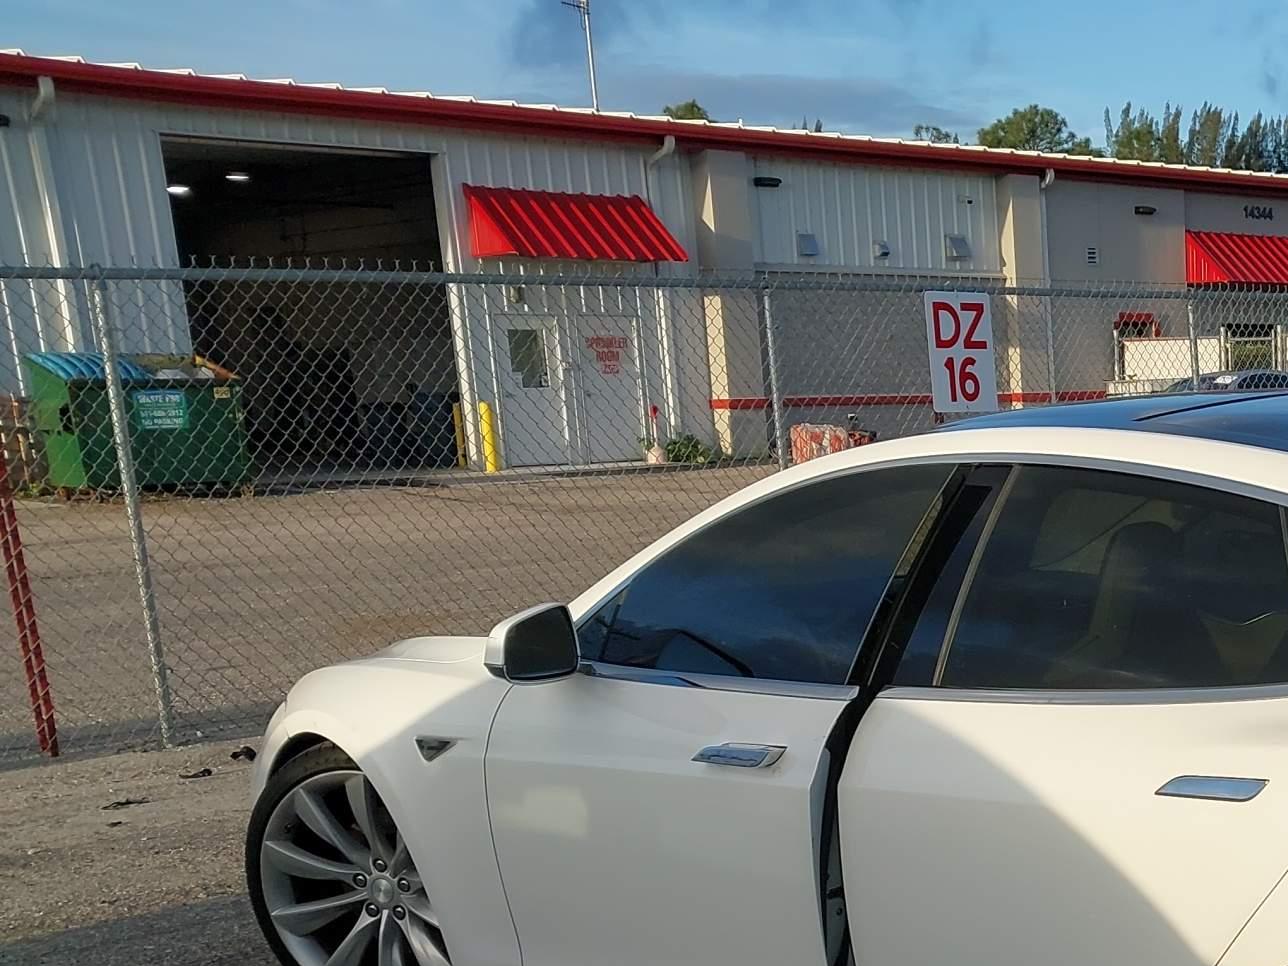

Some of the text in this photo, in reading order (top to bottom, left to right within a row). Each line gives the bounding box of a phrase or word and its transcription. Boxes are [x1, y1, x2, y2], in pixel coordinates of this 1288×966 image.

[1243, 205, 1274, 221] 14344
[932, 301, 988, 350] DZ
[944, 356, 980, 403] 16
